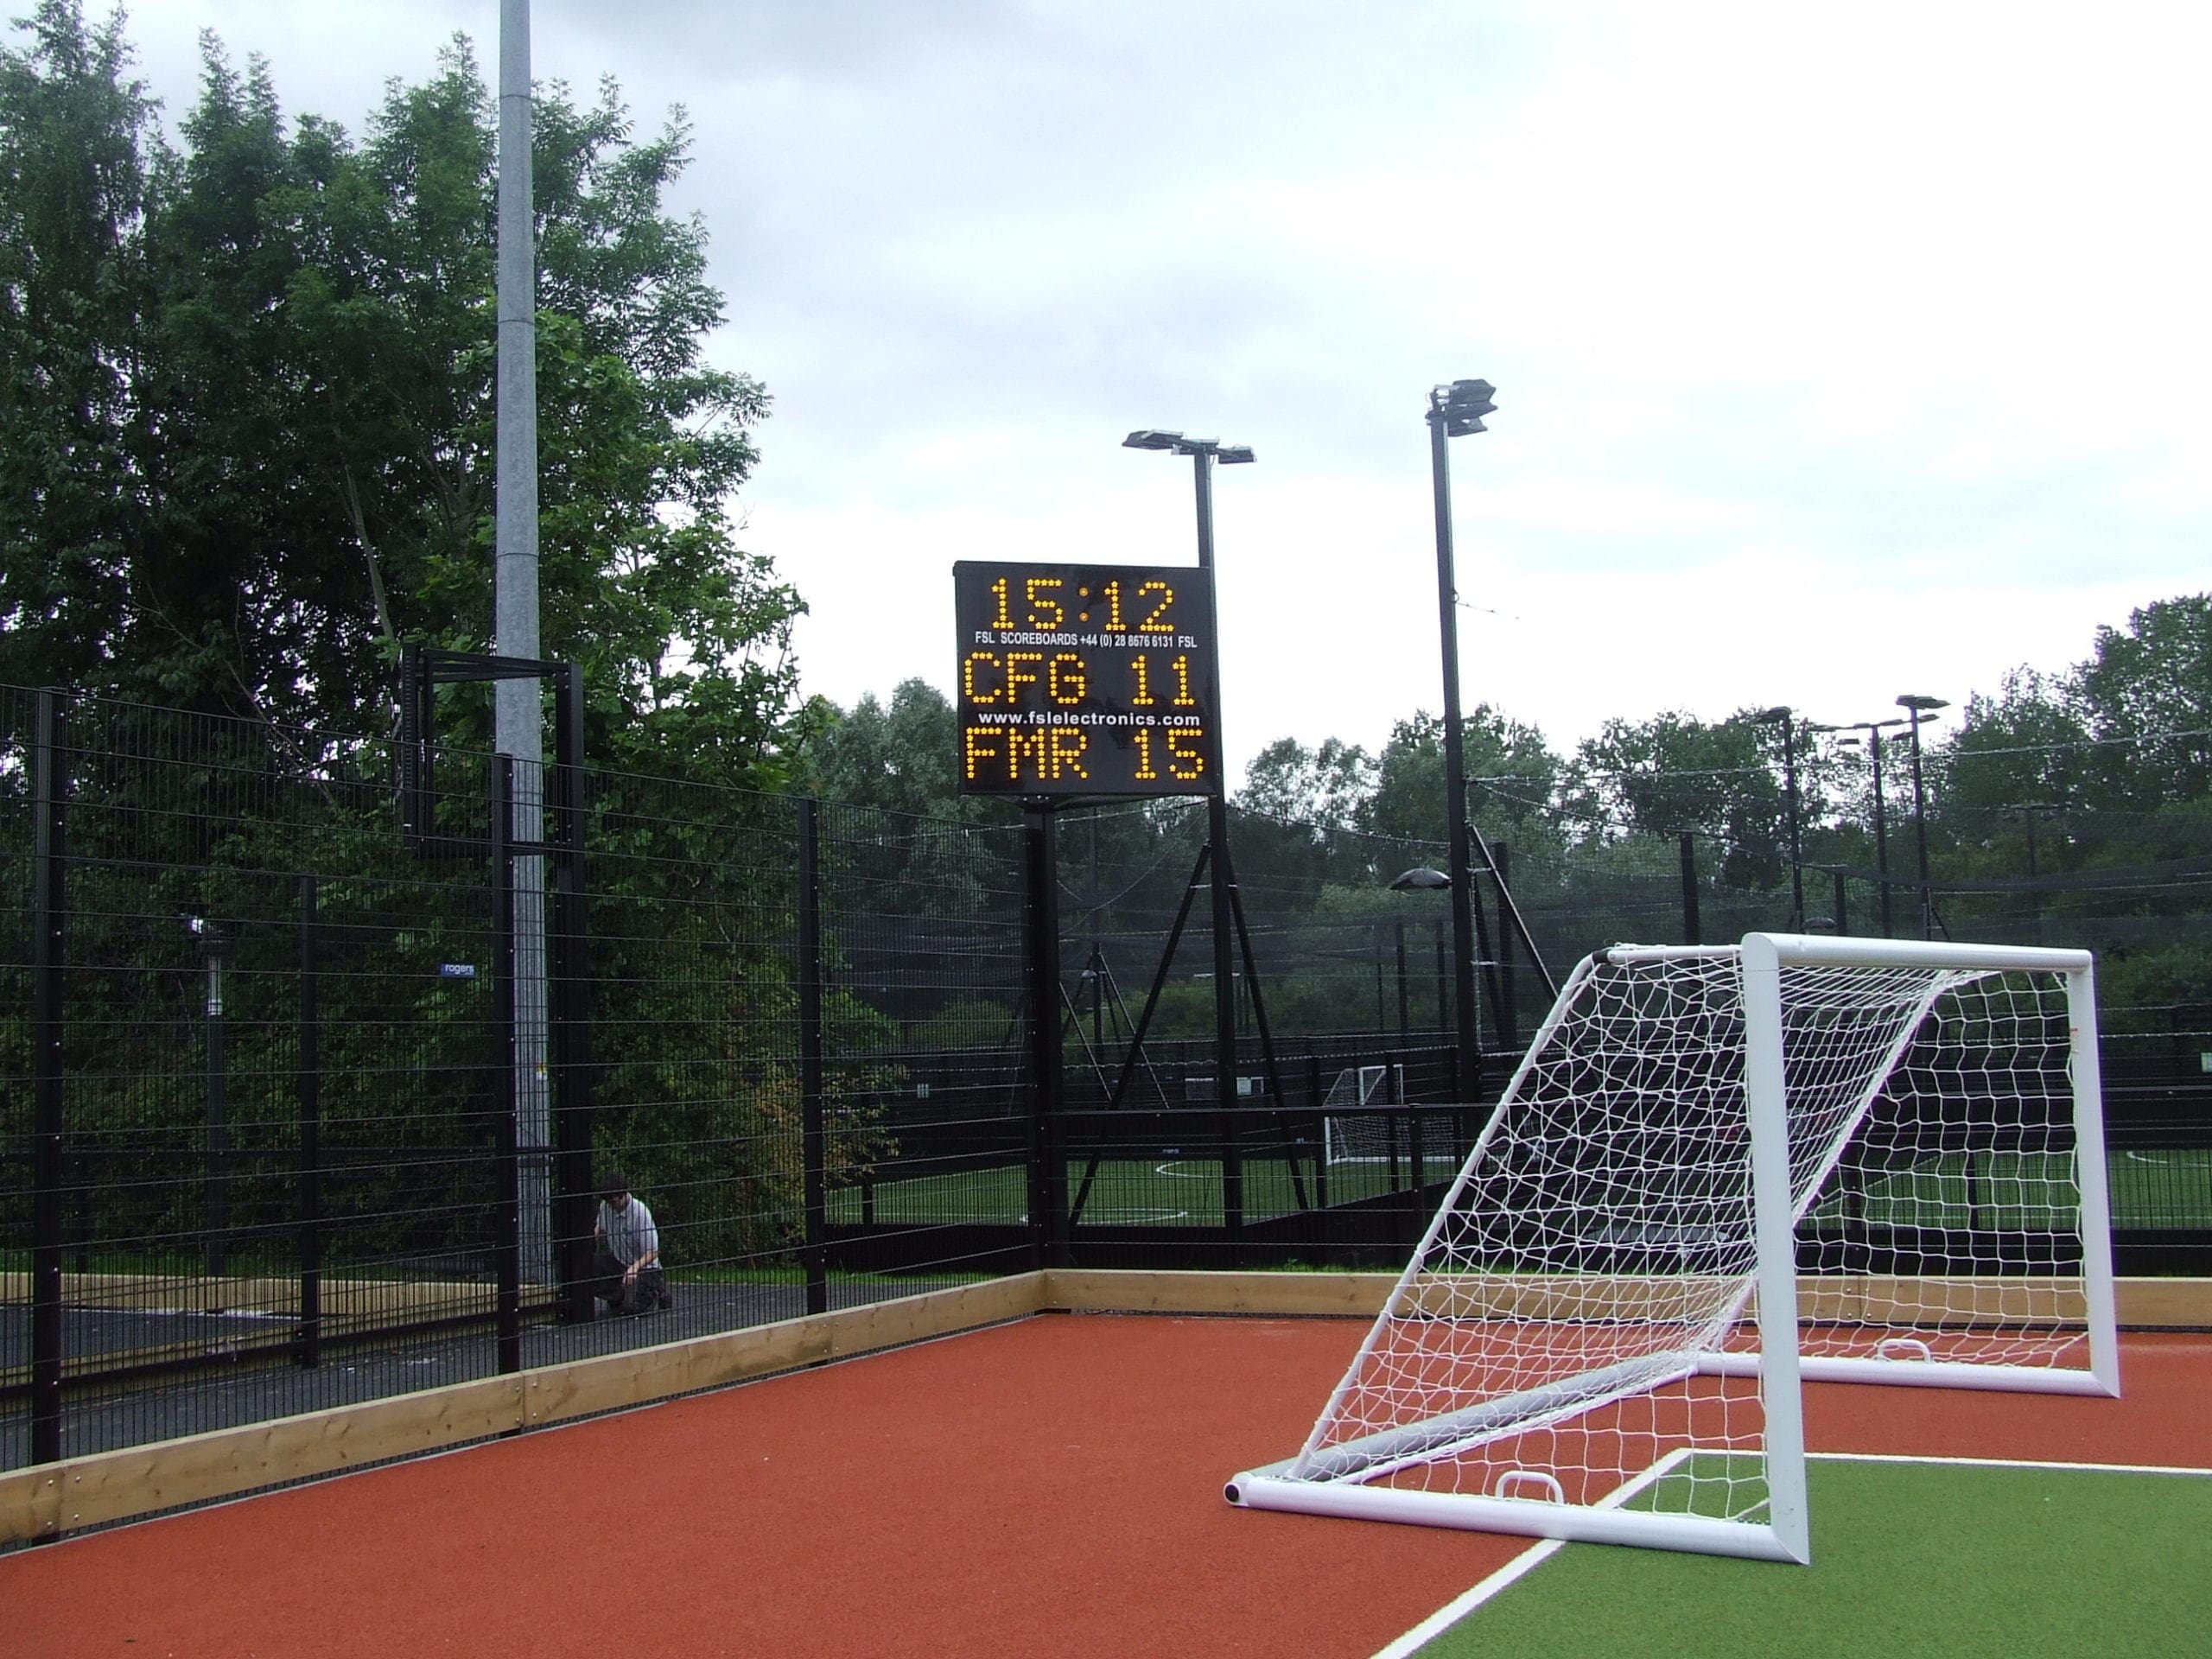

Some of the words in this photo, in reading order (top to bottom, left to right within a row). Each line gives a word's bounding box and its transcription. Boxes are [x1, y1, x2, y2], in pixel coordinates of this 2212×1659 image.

[991, 576, 1175, 632] 15:12
[975, 631, 995, 644] FSL
[1001, 632, 1077, 645] SCOREBOARDS
[1079, 634, 1098, 646] +44
[1099, 634, 1113, 648] (0)
[1115, 634, 1127, 647] 28
[1152, 635, 1173, 648] 6131
[1178, 635, 1198, 648] FSL
[963, 651, 1088, 705] CFG
[1131, 653, 1196, 706] 11
[978, 710, 1200, 727] www.fslelectronics.com
[965, 728, 1089, 779] FMR
[1134, 728, 1204, 779] 15
